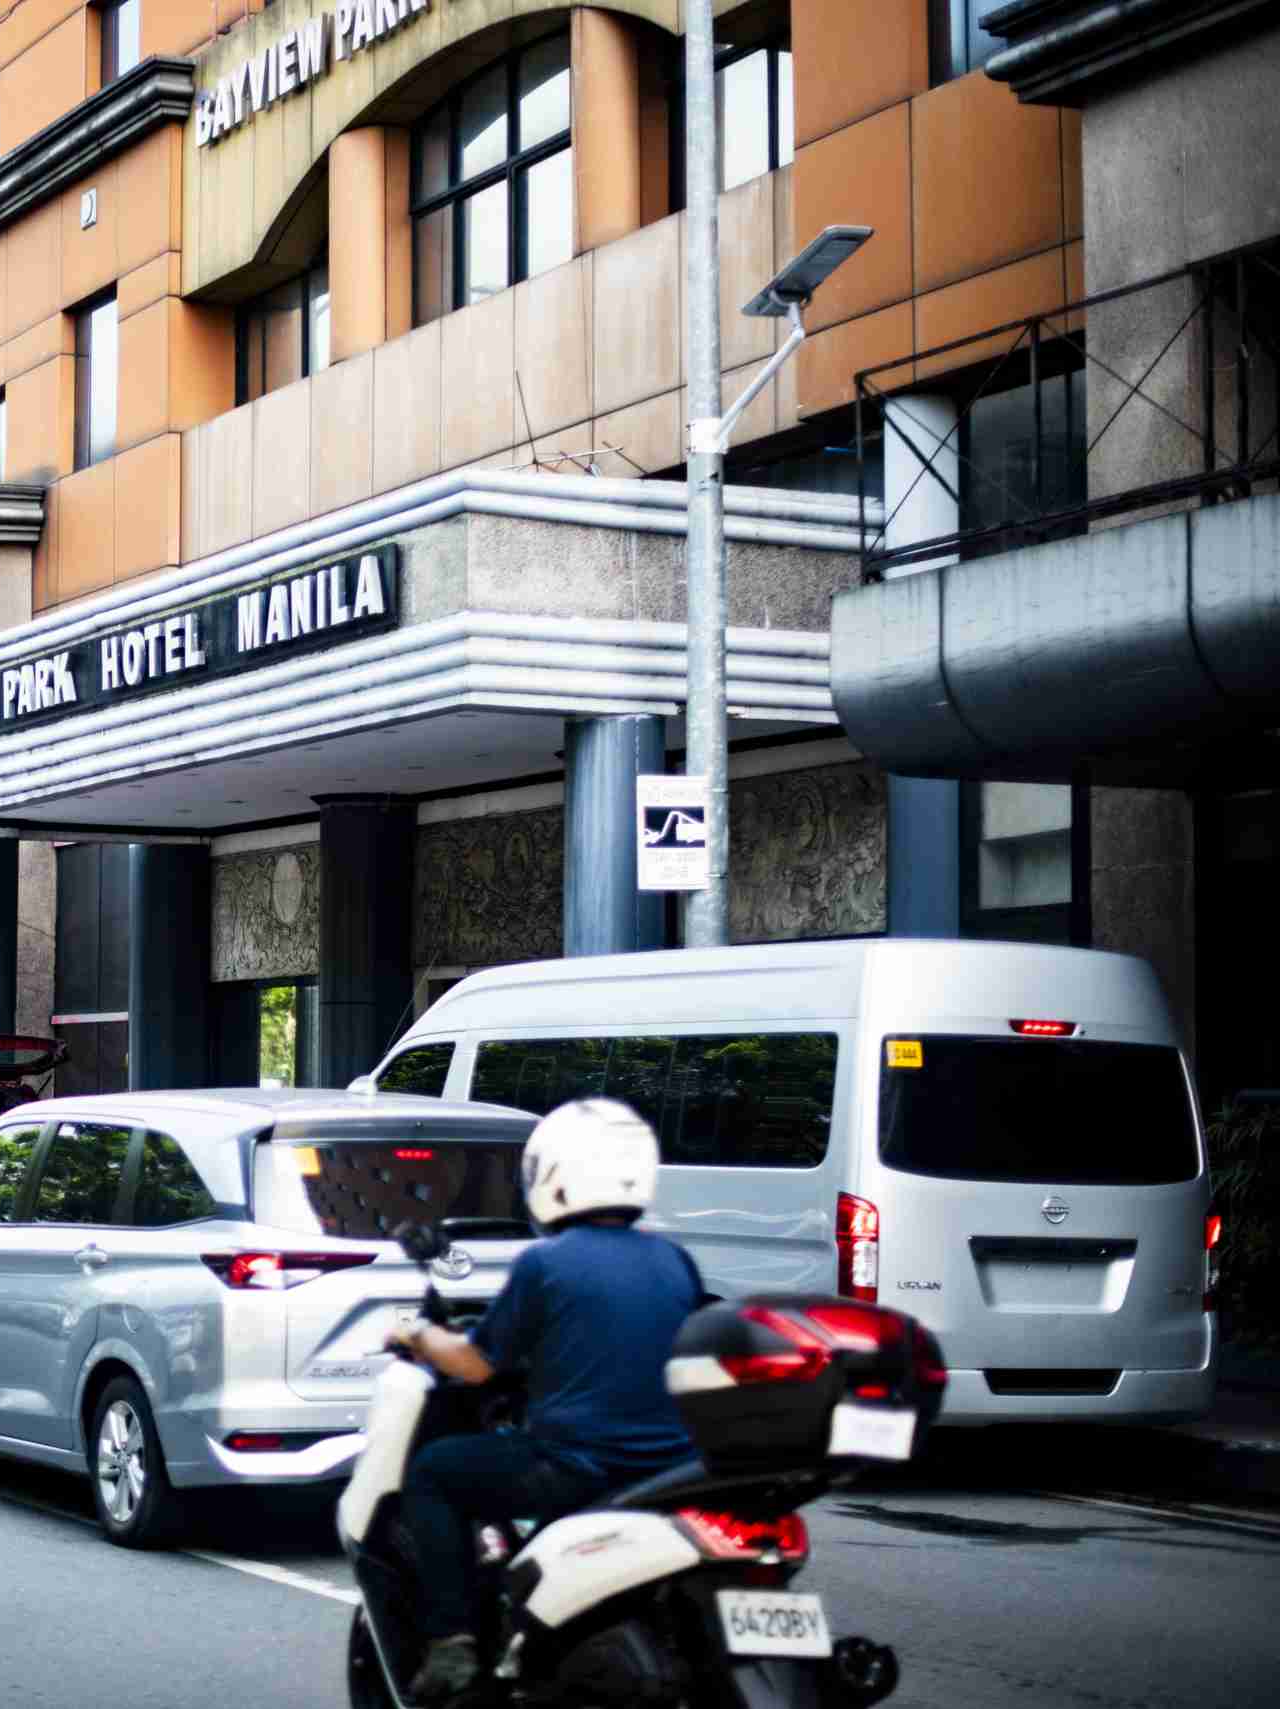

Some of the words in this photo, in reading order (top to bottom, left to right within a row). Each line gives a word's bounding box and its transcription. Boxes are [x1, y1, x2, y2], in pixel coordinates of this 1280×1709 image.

[195, 14, 324, 148] BAYVIEW
[335, 0, 428, 60] PAR
[3, 652, 78, 720] PARK
[101, 613, 206, 691] HOTEL
[237, 554, 387, 653] MANILA
